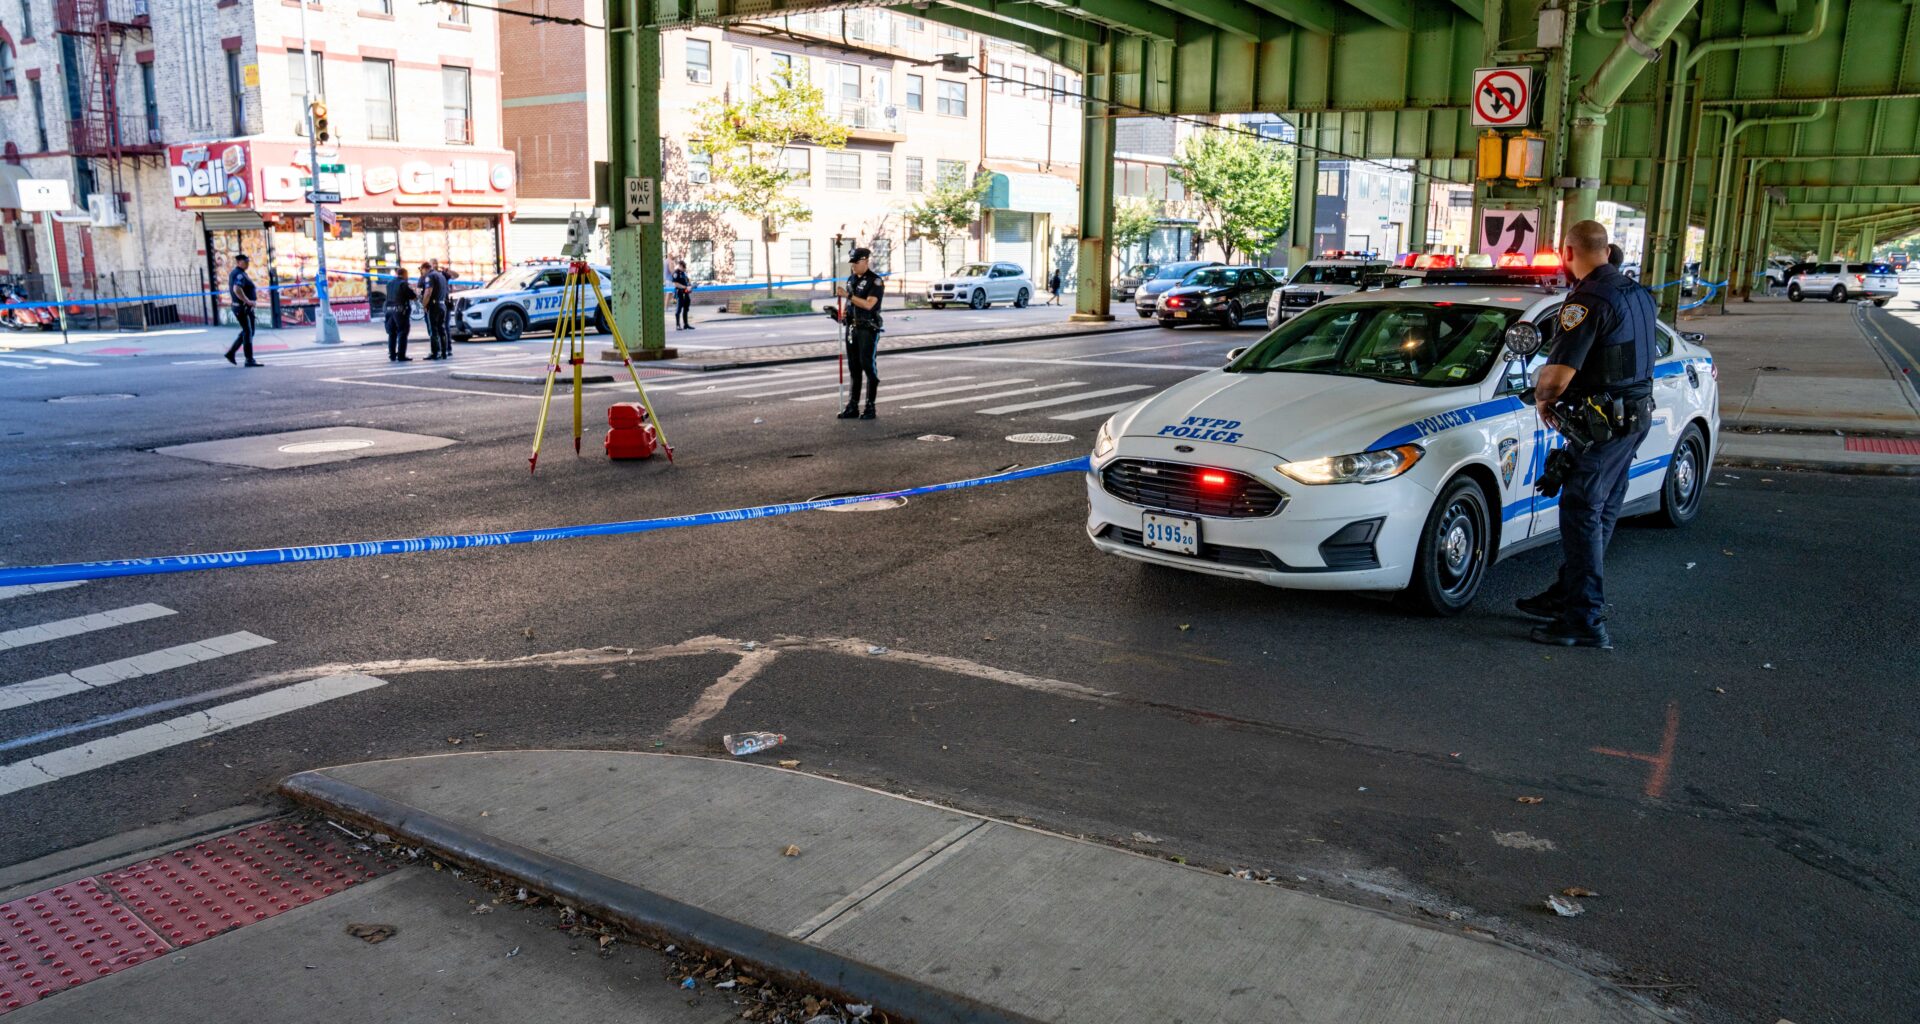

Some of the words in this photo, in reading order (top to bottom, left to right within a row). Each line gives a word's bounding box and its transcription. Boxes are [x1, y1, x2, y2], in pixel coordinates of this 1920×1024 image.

[170, 159, 225, 197] Deli
[399, 160, 489, 194] Grill
[630, 181, 649, 191] ONE
[630, 194, 649, 204] WAY
[330, 307, 369, 319] udweiser
[1181, 416, 1241, 430] NYPD
[1414, 410, 1463, 437] POLICE
[1157, 425, 1244, 443] POLICE
[1147, 523, 1181, 543] 3195
[1182, 536, 1193, 545] 20
